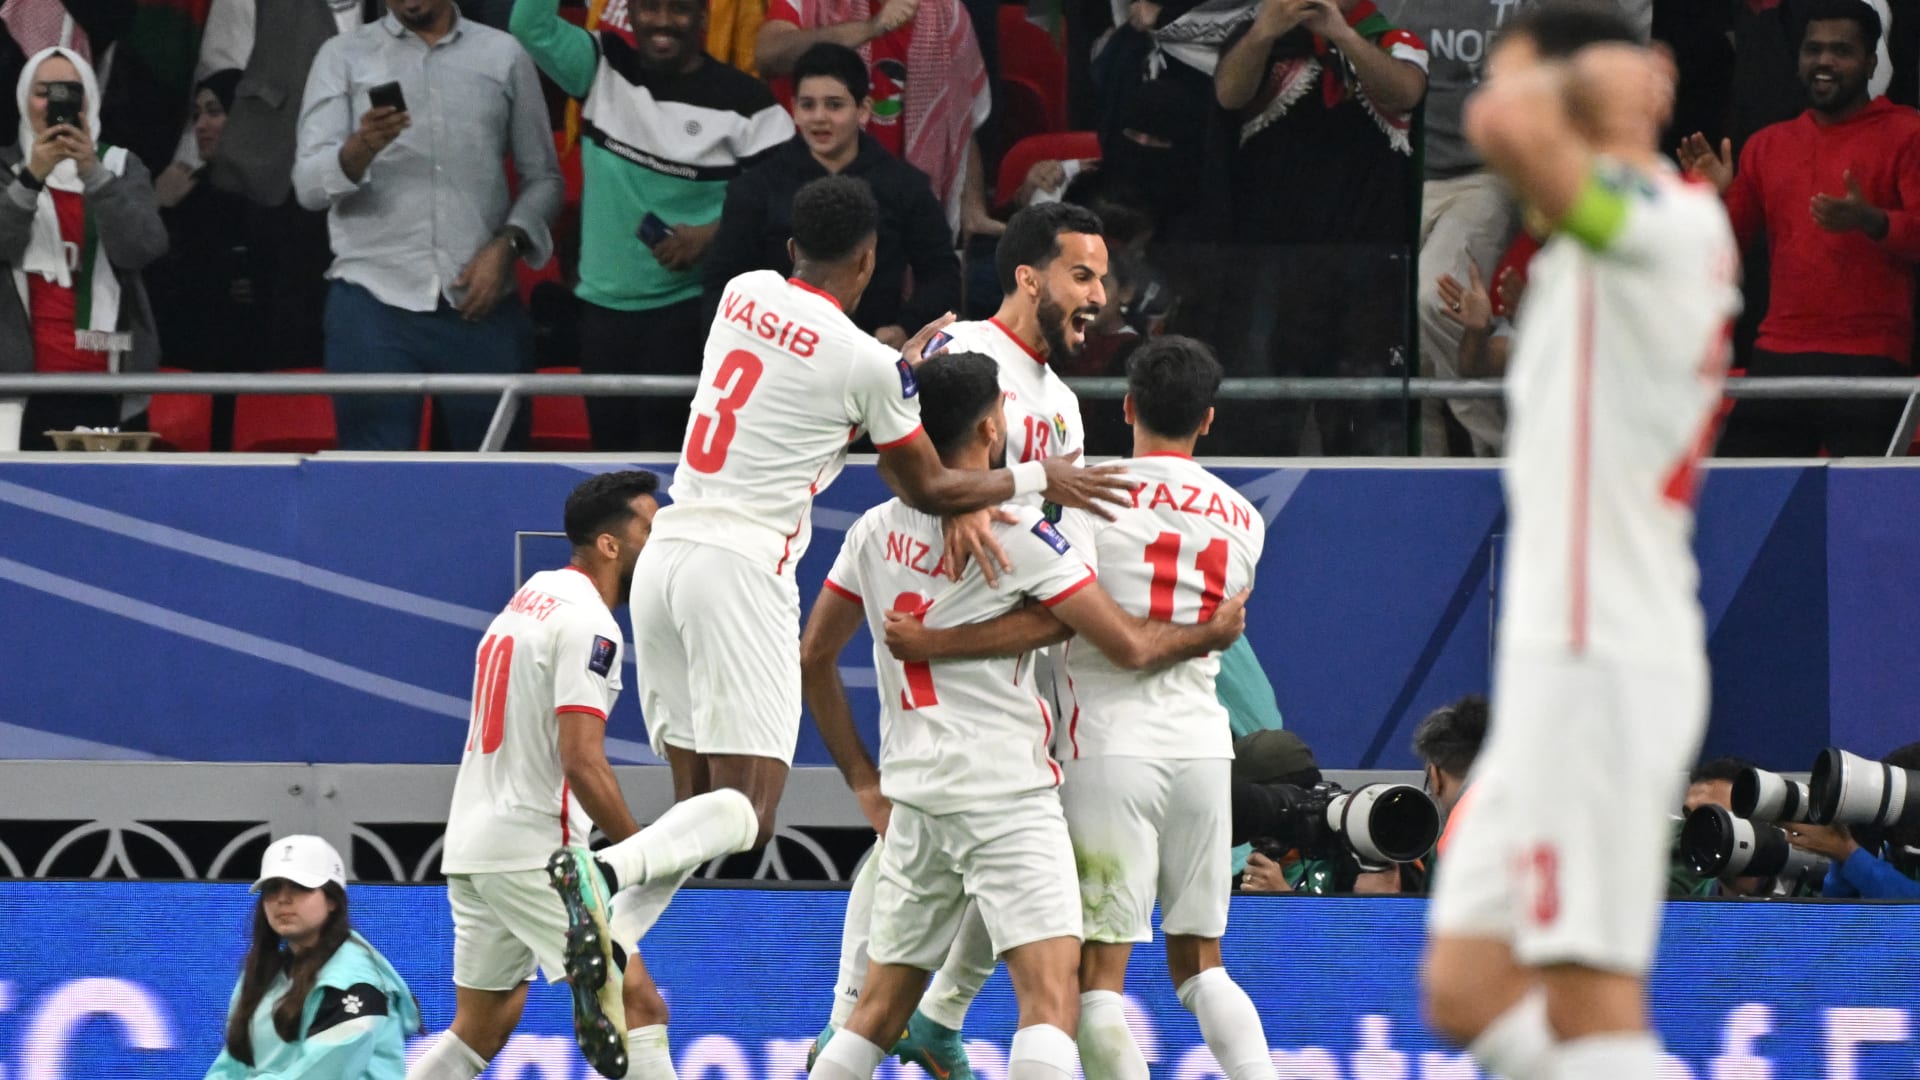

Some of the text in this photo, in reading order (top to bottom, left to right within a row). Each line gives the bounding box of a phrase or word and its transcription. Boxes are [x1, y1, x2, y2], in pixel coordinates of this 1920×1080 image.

[720, 291, 820, 358] NASIB
[686, 349, 764, 474] 3
[1019, 415, 1050, 464] 13
[1128, 482, 1251, 531] YAZAN
[886, 531, 963, 580] NIZ
[1144, 531, 1229, 640] 11
[467, 634, 514, 754] 10
[845, 986, 860, 998] JA
